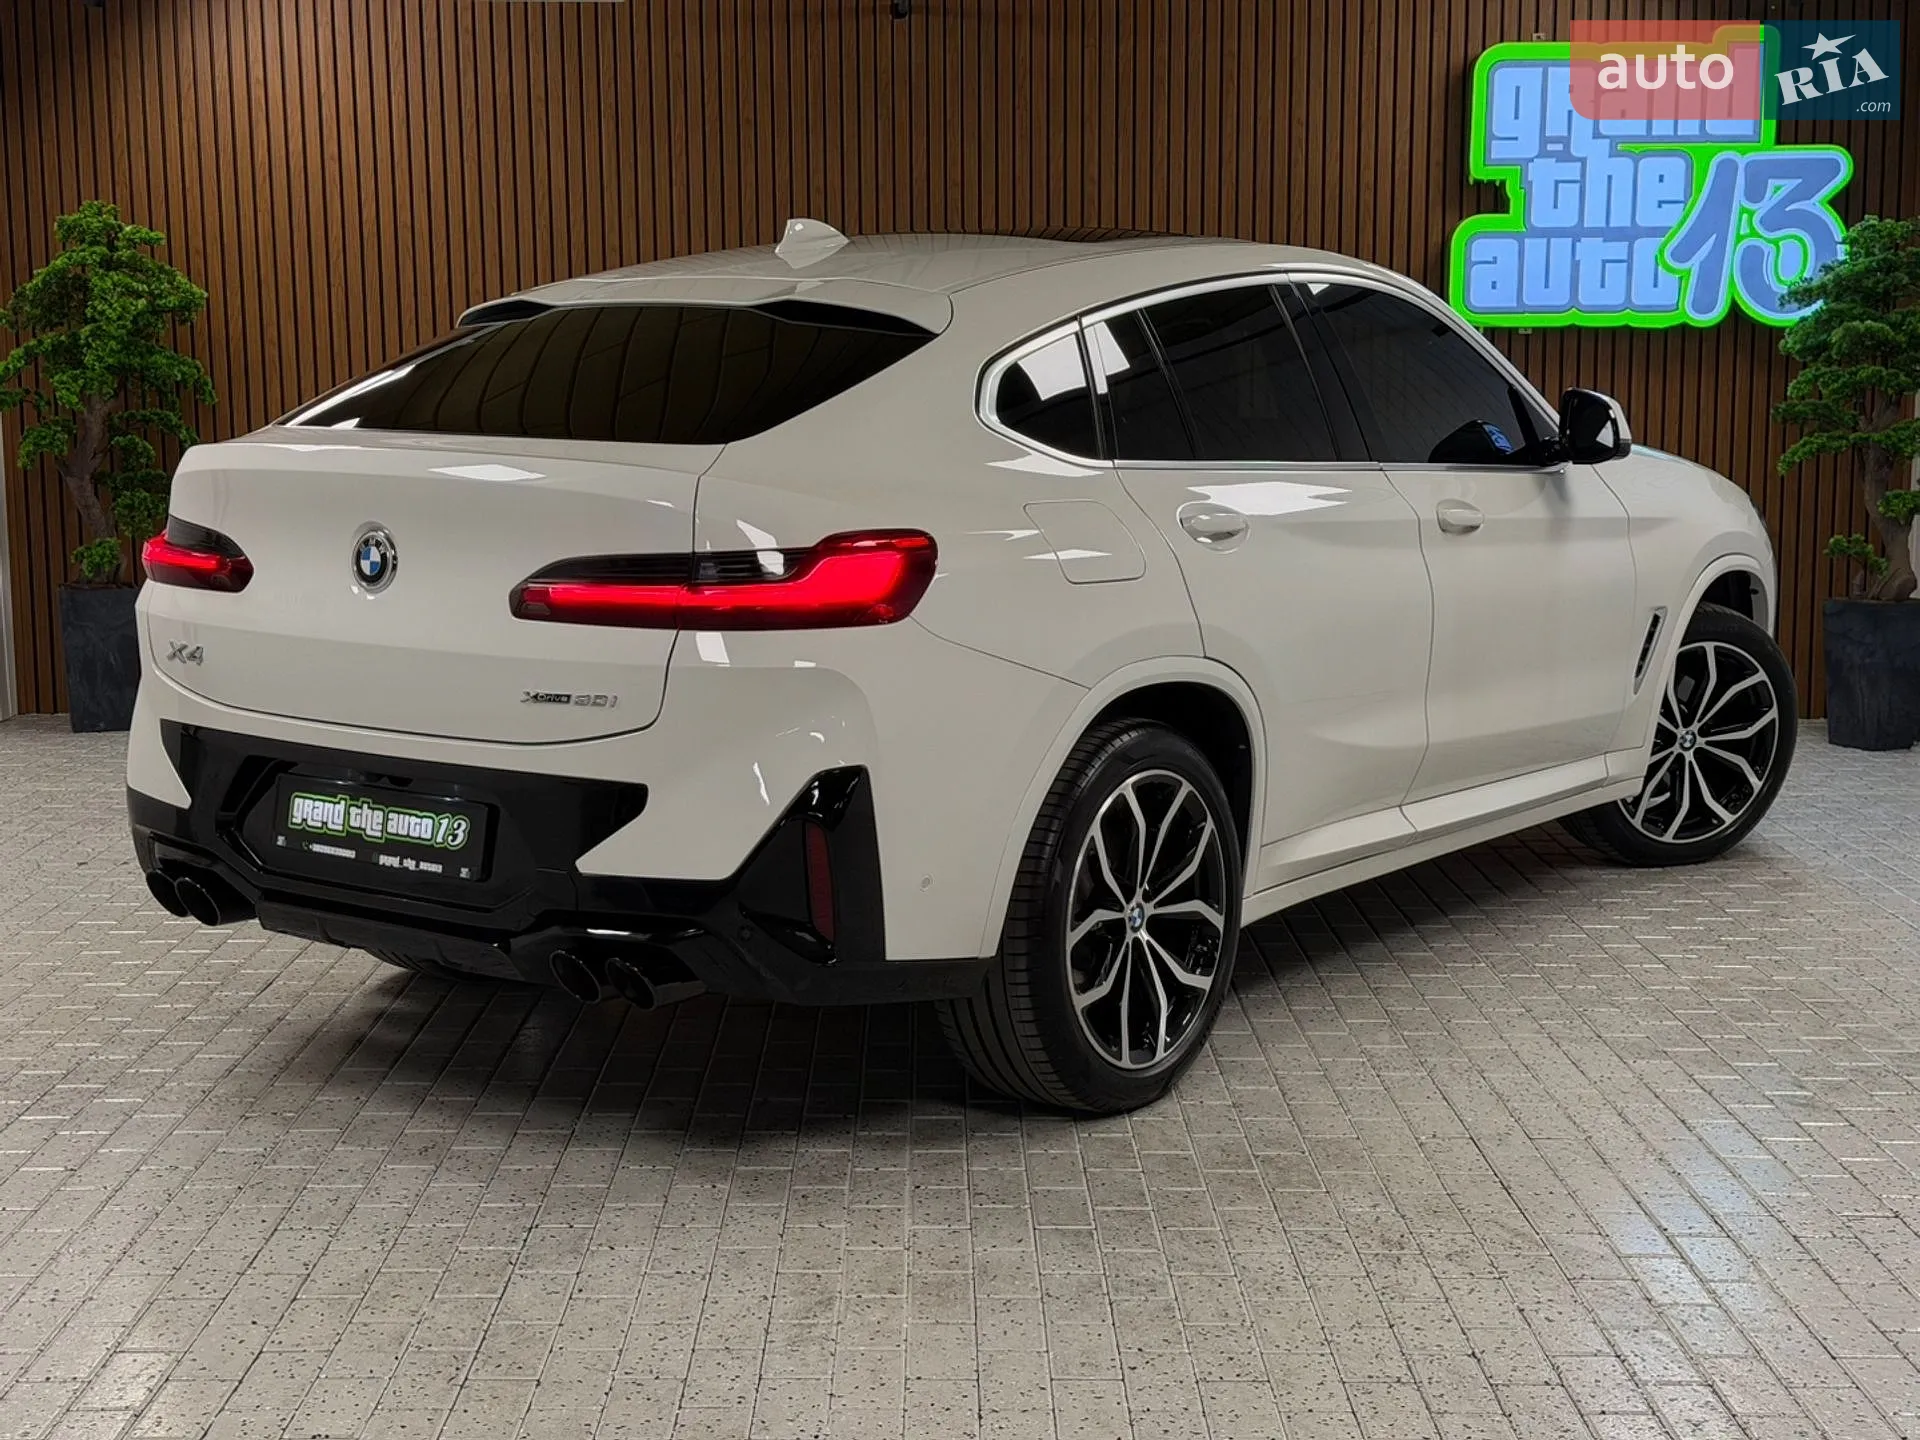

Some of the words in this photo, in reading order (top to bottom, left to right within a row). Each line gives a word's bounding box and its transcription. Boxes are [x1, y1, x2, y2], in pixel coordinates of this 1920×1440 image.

[1528, 139, 1688, 228] the
[1470, 237, 1682, 310] auto
[1667, 151, 1846, 318] 13
[167, 640, 204, 666] X4
[292, 797, 346, 831] grand
[349, 800, 384, 838] the
[386, 812, 434, 841] auto
[435, 817, 468, 848] 13
